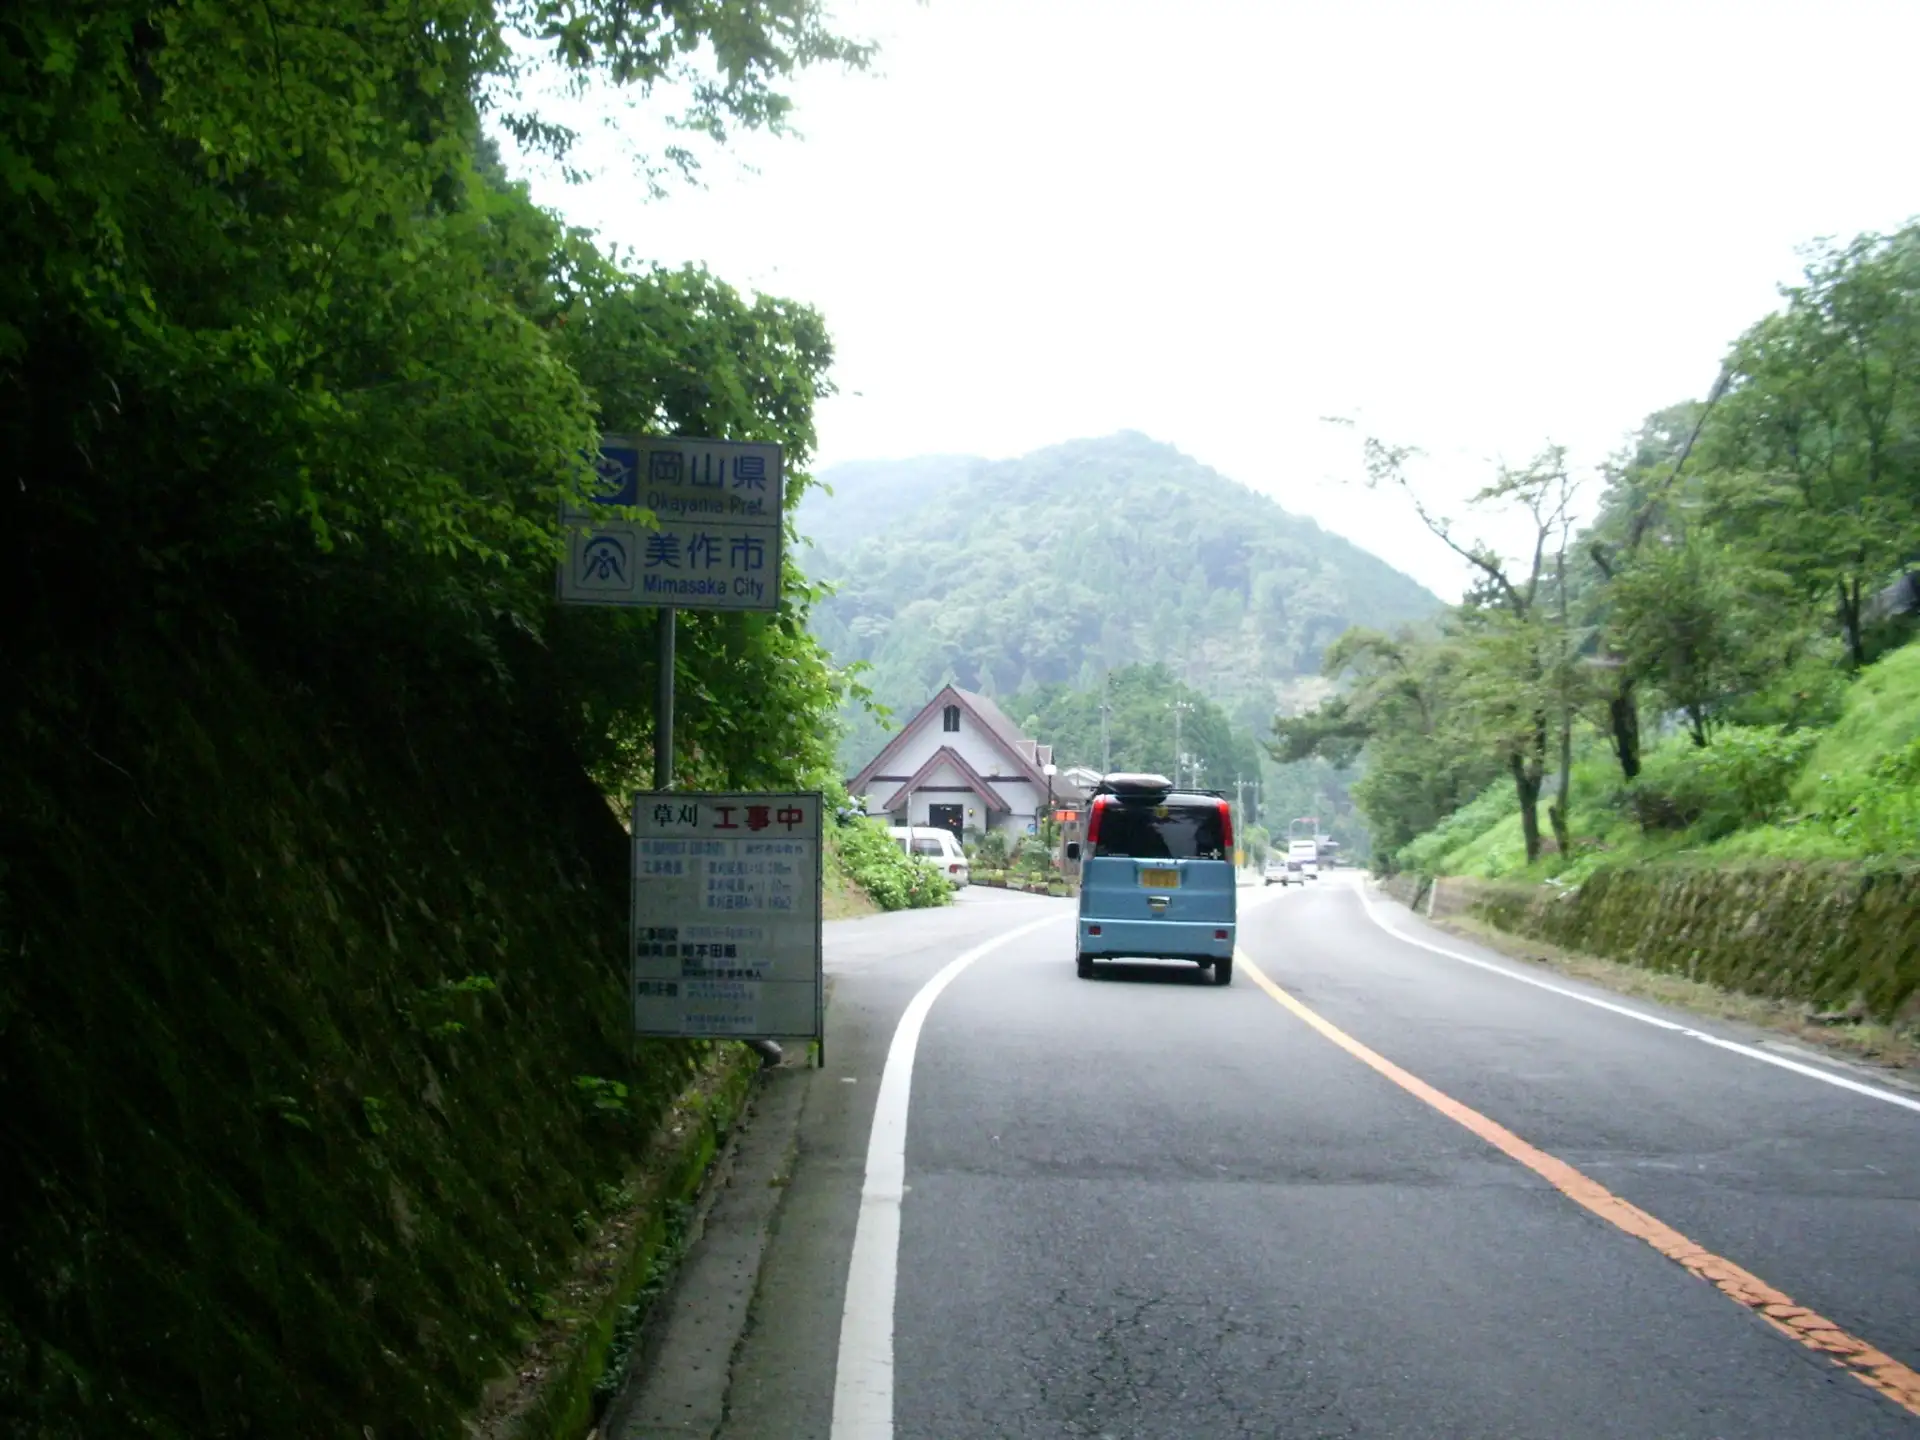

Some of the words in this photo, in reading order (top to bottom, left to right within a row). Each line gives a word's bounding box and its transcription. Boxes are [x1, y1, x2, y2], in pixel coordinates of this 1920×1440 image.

[648, 450, 767, 492] 岡山県
[647, 491, 724, 516] Okayama
[729, 495, 768, 516] Pref.
[644, 532, 766, 572] 美作市
[643, 574, 727, 596] Mimasaka
[734, 575, 765, 600] City
[653, 803, 698, 828] 草刈
[713, 803, 804, 832] 工事中
